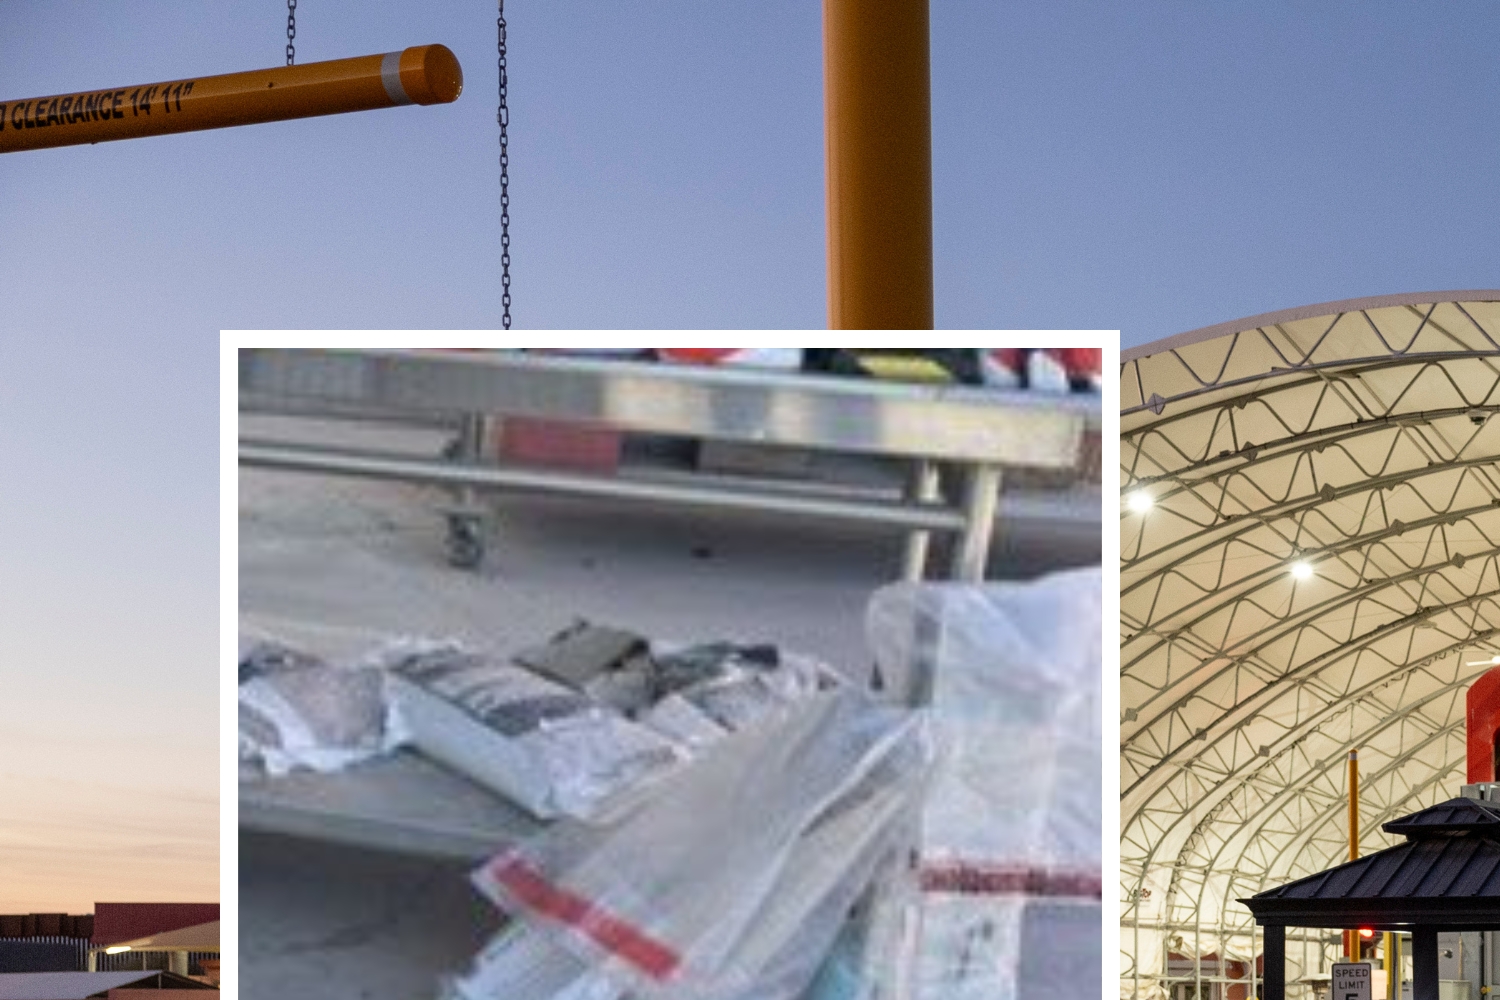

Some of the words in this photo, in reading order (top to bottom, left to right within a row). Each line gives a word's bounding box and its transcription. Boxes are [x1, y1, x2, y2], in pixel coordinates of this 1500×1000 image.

[11, 90, 125, 130] CLEARANCE
[1335, 969, 1369, 978] SPEED
[1338, 980, 1365, 990] LIMIT
